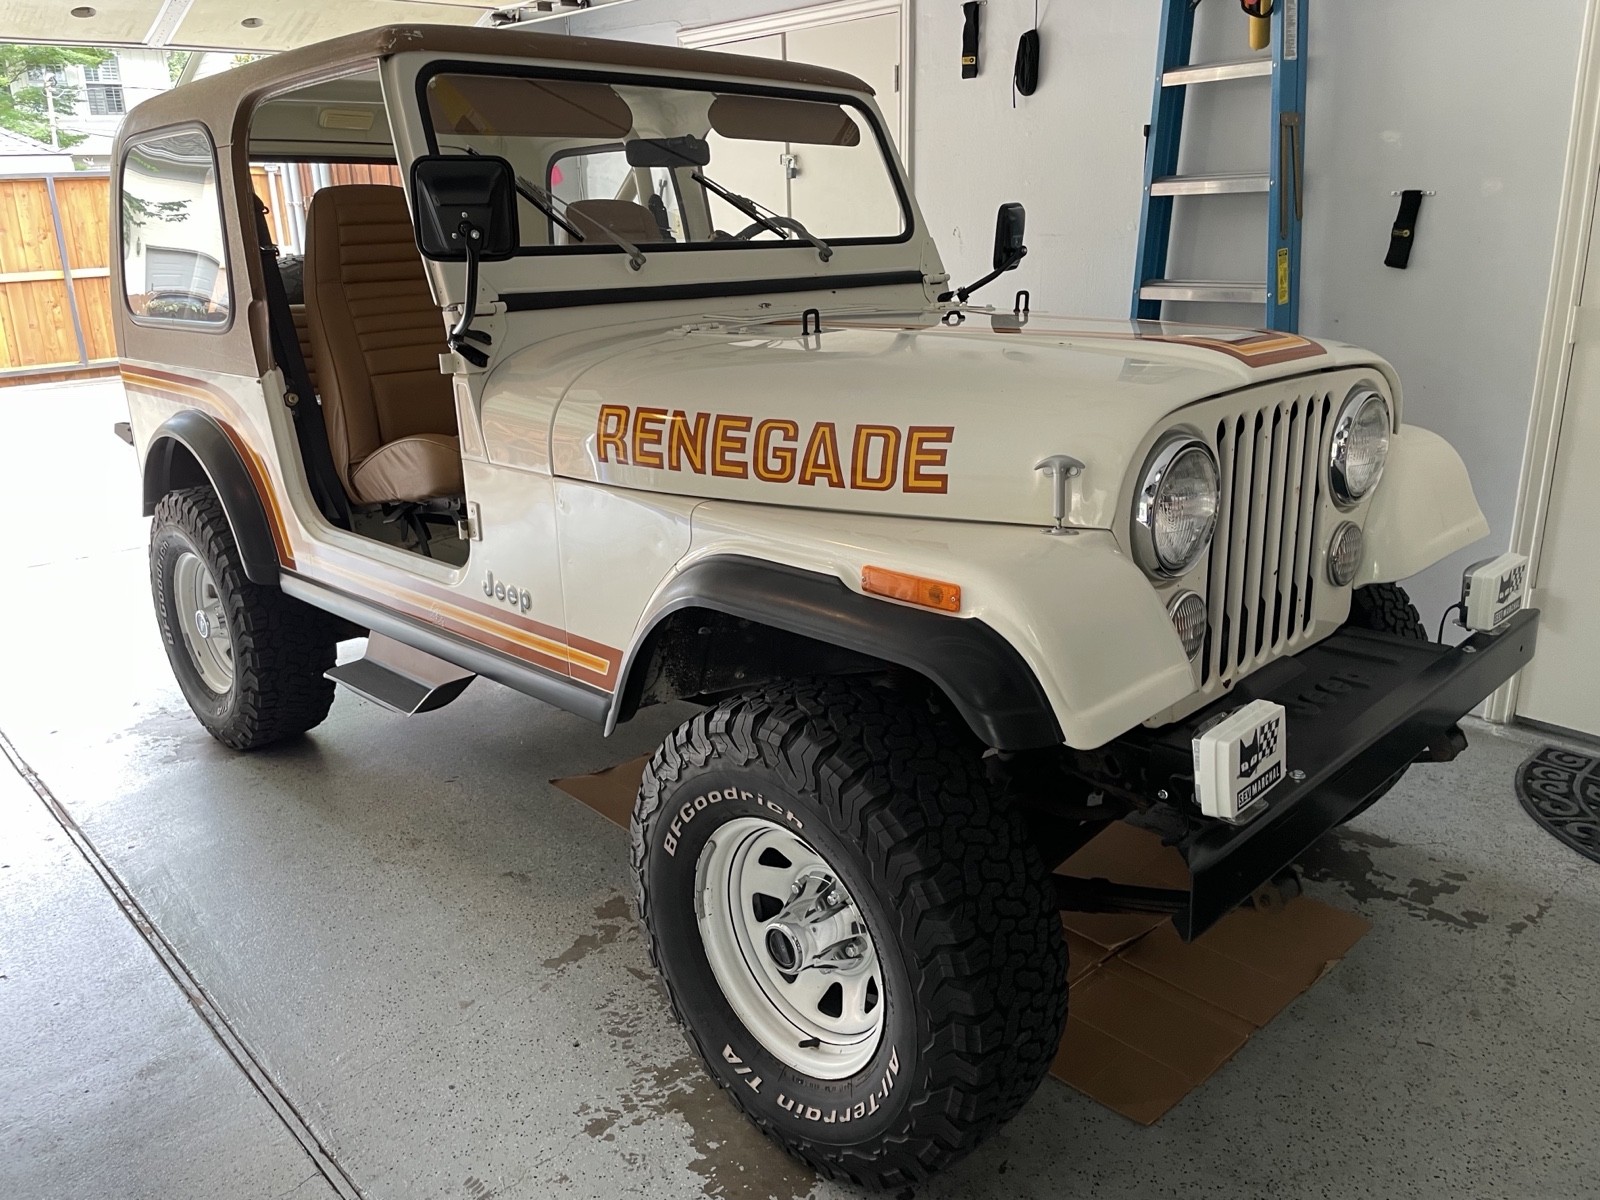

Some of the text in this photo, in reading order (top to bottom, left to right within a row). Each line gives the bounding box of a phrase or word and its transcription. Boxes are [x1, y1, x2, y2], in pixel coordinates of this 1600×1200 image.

[597, 404, 954, 494] RENEGADE
[482, 569, 532, 614] Jeep
[1252, 765, 1280, 796] MARCHAL
[663, 786, 804, 857] BFGoodrich
[722, 1043, 900, 1124] All-Terrain T/A
